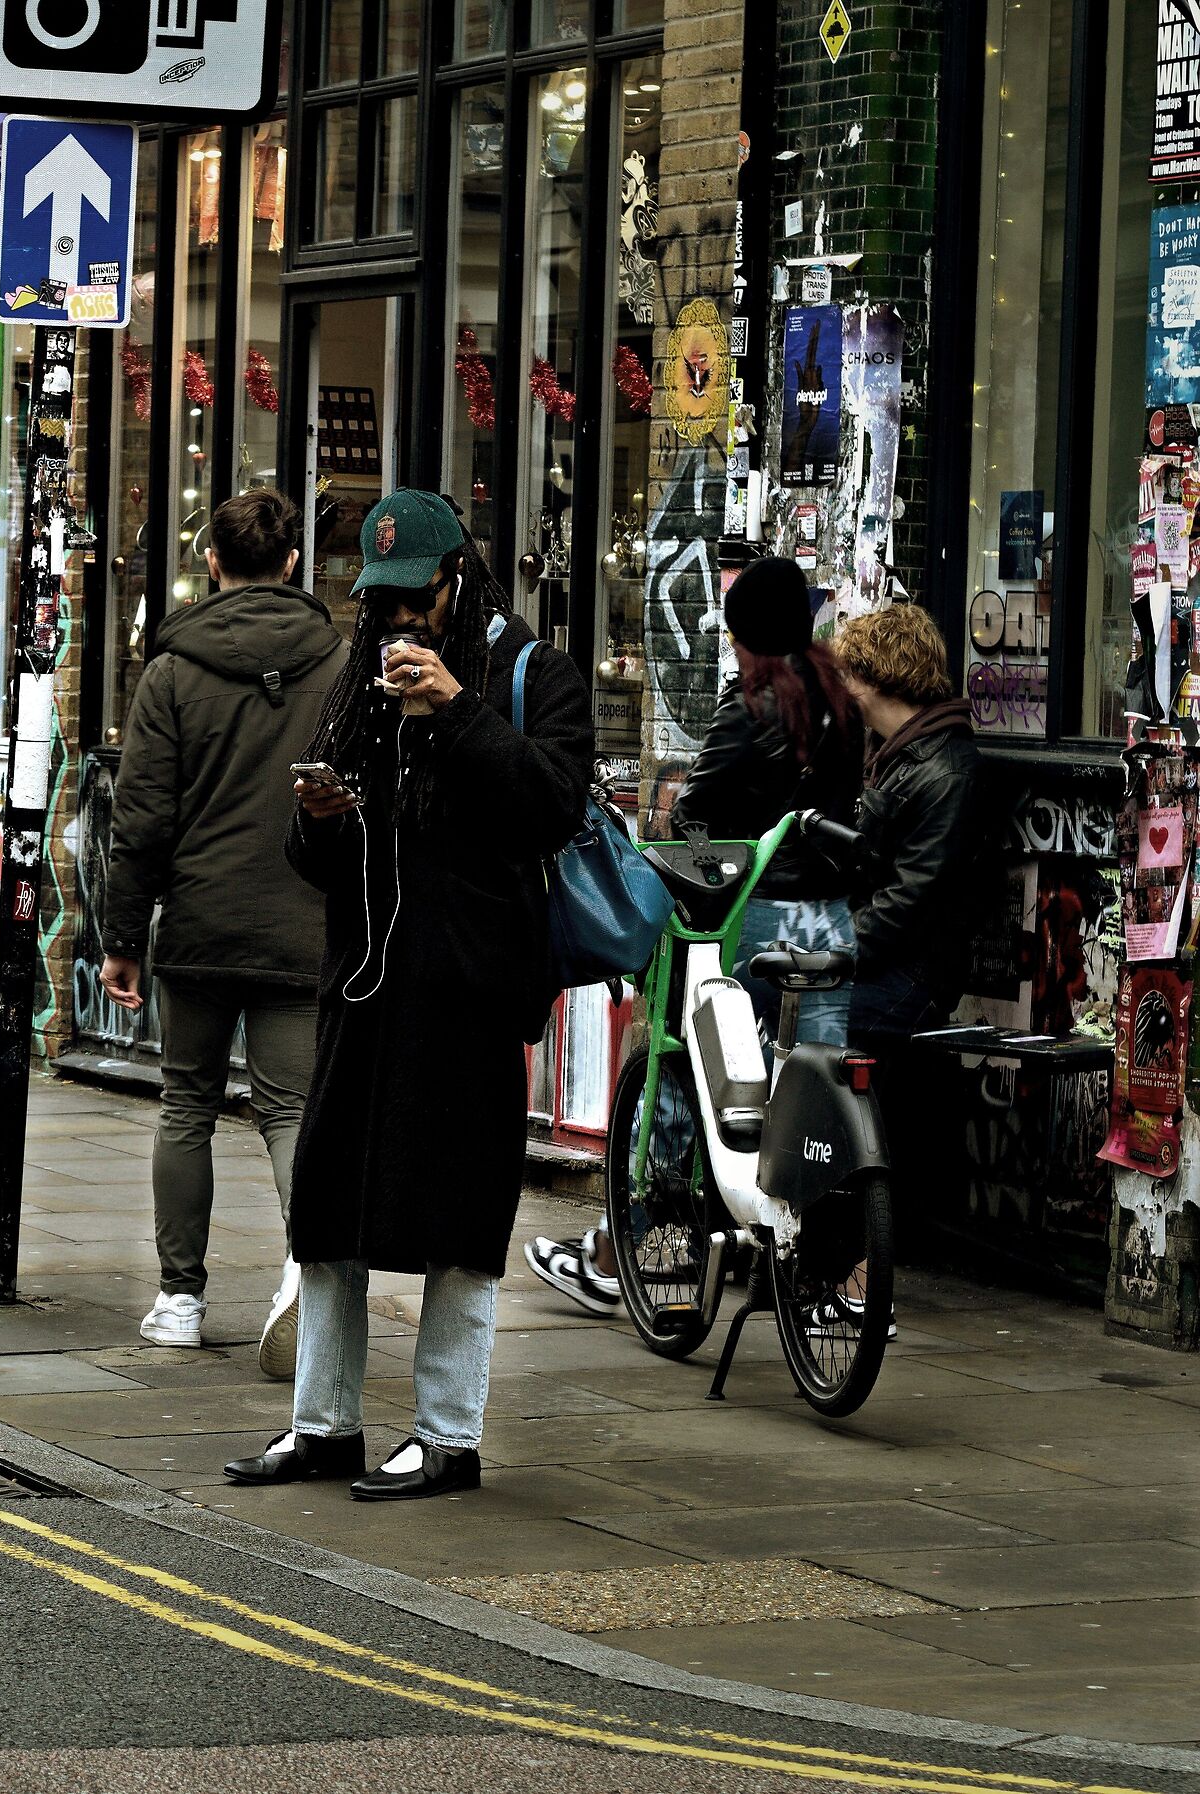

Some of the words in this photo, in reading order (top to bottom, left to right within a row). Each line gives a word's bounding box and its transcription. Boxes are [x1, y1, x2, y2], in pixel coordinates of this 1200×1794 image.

[161, 58, 204, 82] INCEPTION
[1157, 59, 1200, 96] WALK
[1155, 97, 1182, 111] Sundays
[1155, 113, 1173, 128] 11am
[1154, 132, 1167, 143] Front
[1167, 131, 1173, 141] of
[1173, 129, 1194, 140] Criterion
[1154, 142, 1177, 154] Piccadilly
[1177, 141, 1194, 151] Circus
[1158, 218, 1183, 238] DONT
[1159, 242, 1169, 258] BE
[1171, 232, 1199, 254] WORRY
[808, 291, 825, 299] LIVES
[847, 352, 895, 365] CHAOS
[1009, 527, 1023, 536] Coffee
[1023, 526, 1034, 536] Club
[597, 703, 629, 720] appear
[1131, 1077, 1153, 1086] DECEMBER
